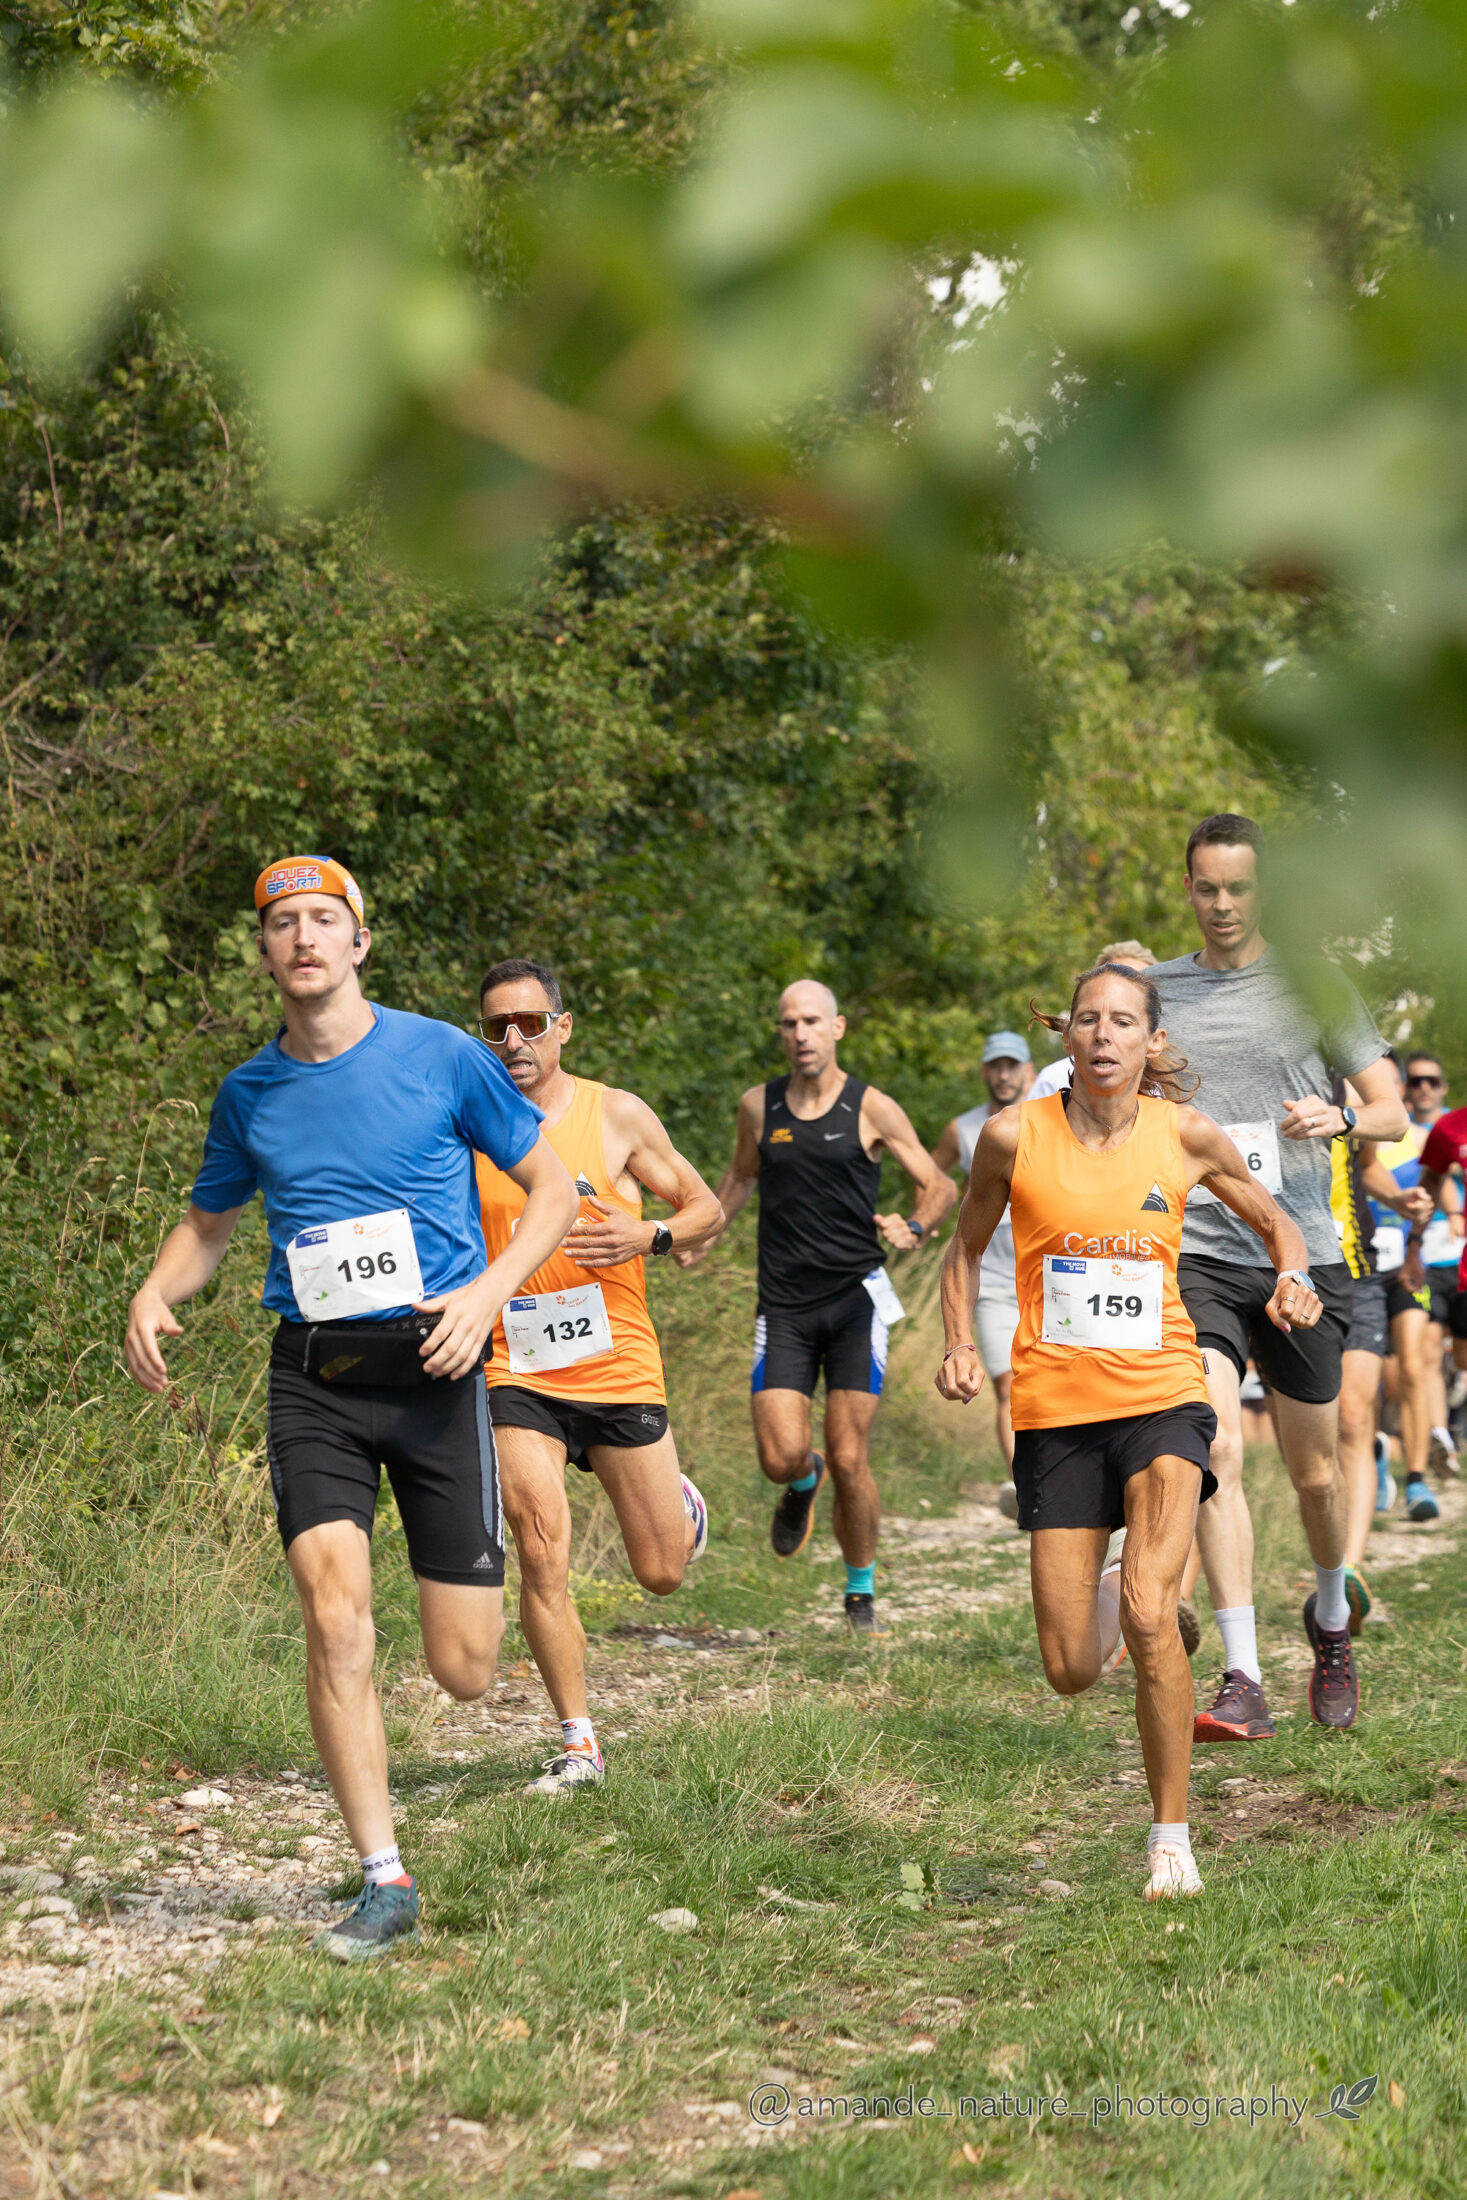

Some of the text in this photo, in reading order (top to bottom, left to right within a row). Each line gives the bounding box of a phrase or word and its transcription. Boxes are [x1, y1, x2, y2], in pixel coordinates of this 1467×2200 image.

[267, 867, 317, 883] JOUEZ
[267, 877, 320, 895] SPORT!
[1063, 1229, 1152, 1256] Cardis
[337, 1251, 397, 1282] 196
[1087, 1294, 1142, 1317] 159
[543, 1317, 593, 1343] 132
